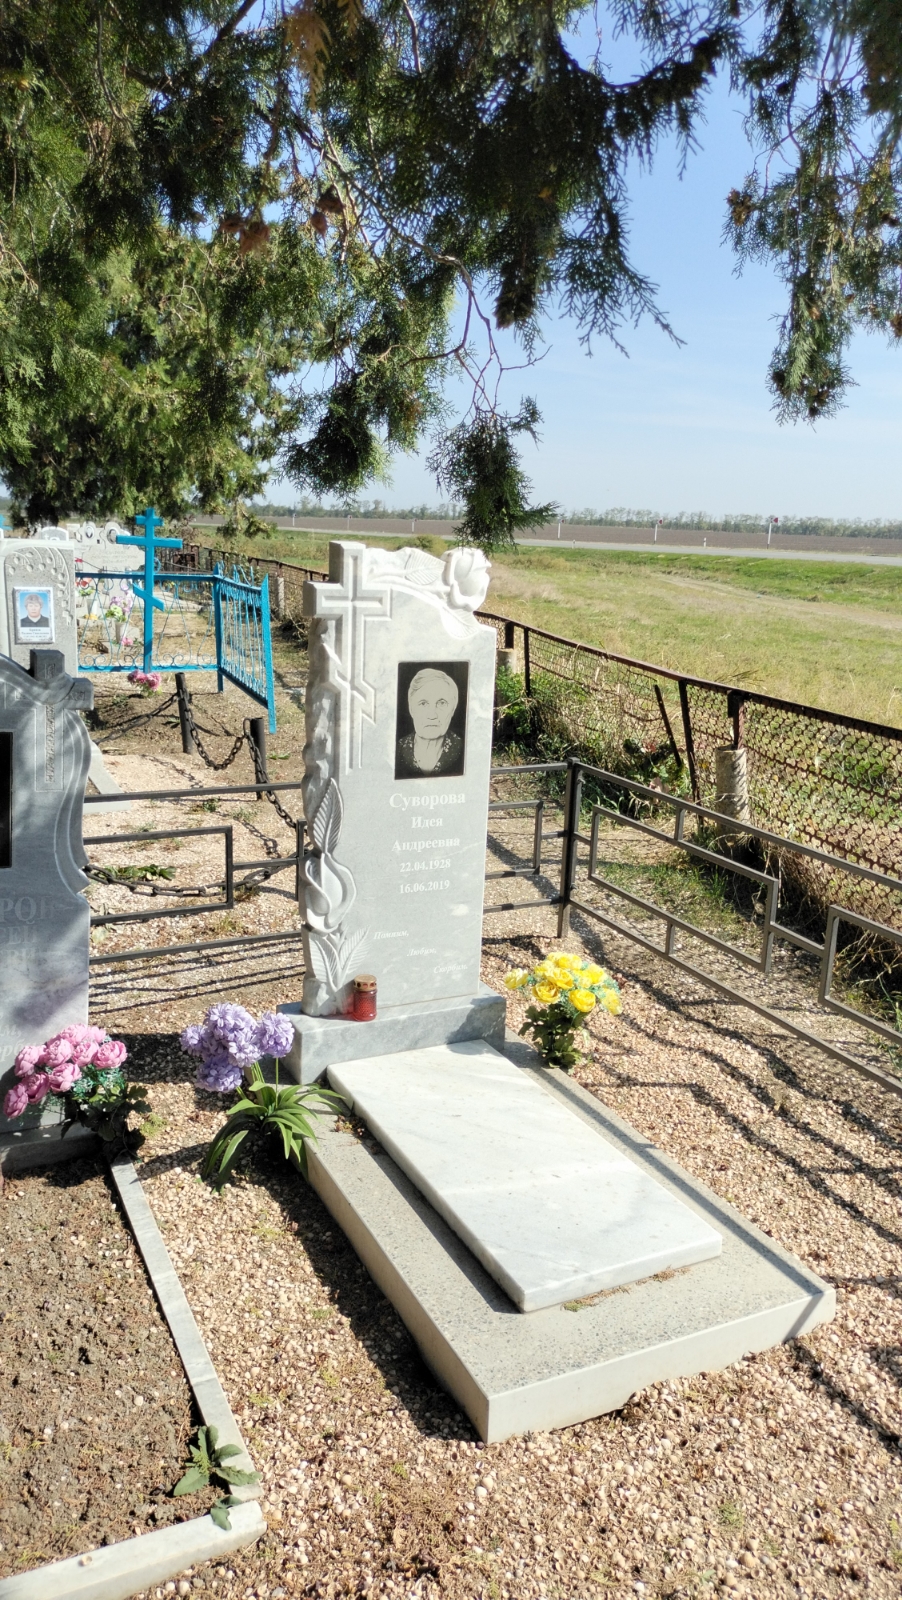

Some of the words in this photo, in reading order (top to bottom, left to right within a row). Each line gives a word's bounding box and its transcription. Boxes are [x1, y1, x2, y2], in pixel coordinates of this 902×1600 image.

[389, 793, 466, 811] Суворова
[411, 816, 444, 829] Идея
[391, 837, 461, 852] Андреевна
[400, 858, 451, 873] 22.04.1928
[400, 879, 450, 894] 16.06.2019
[373, 930, 409, 940] Помним,
